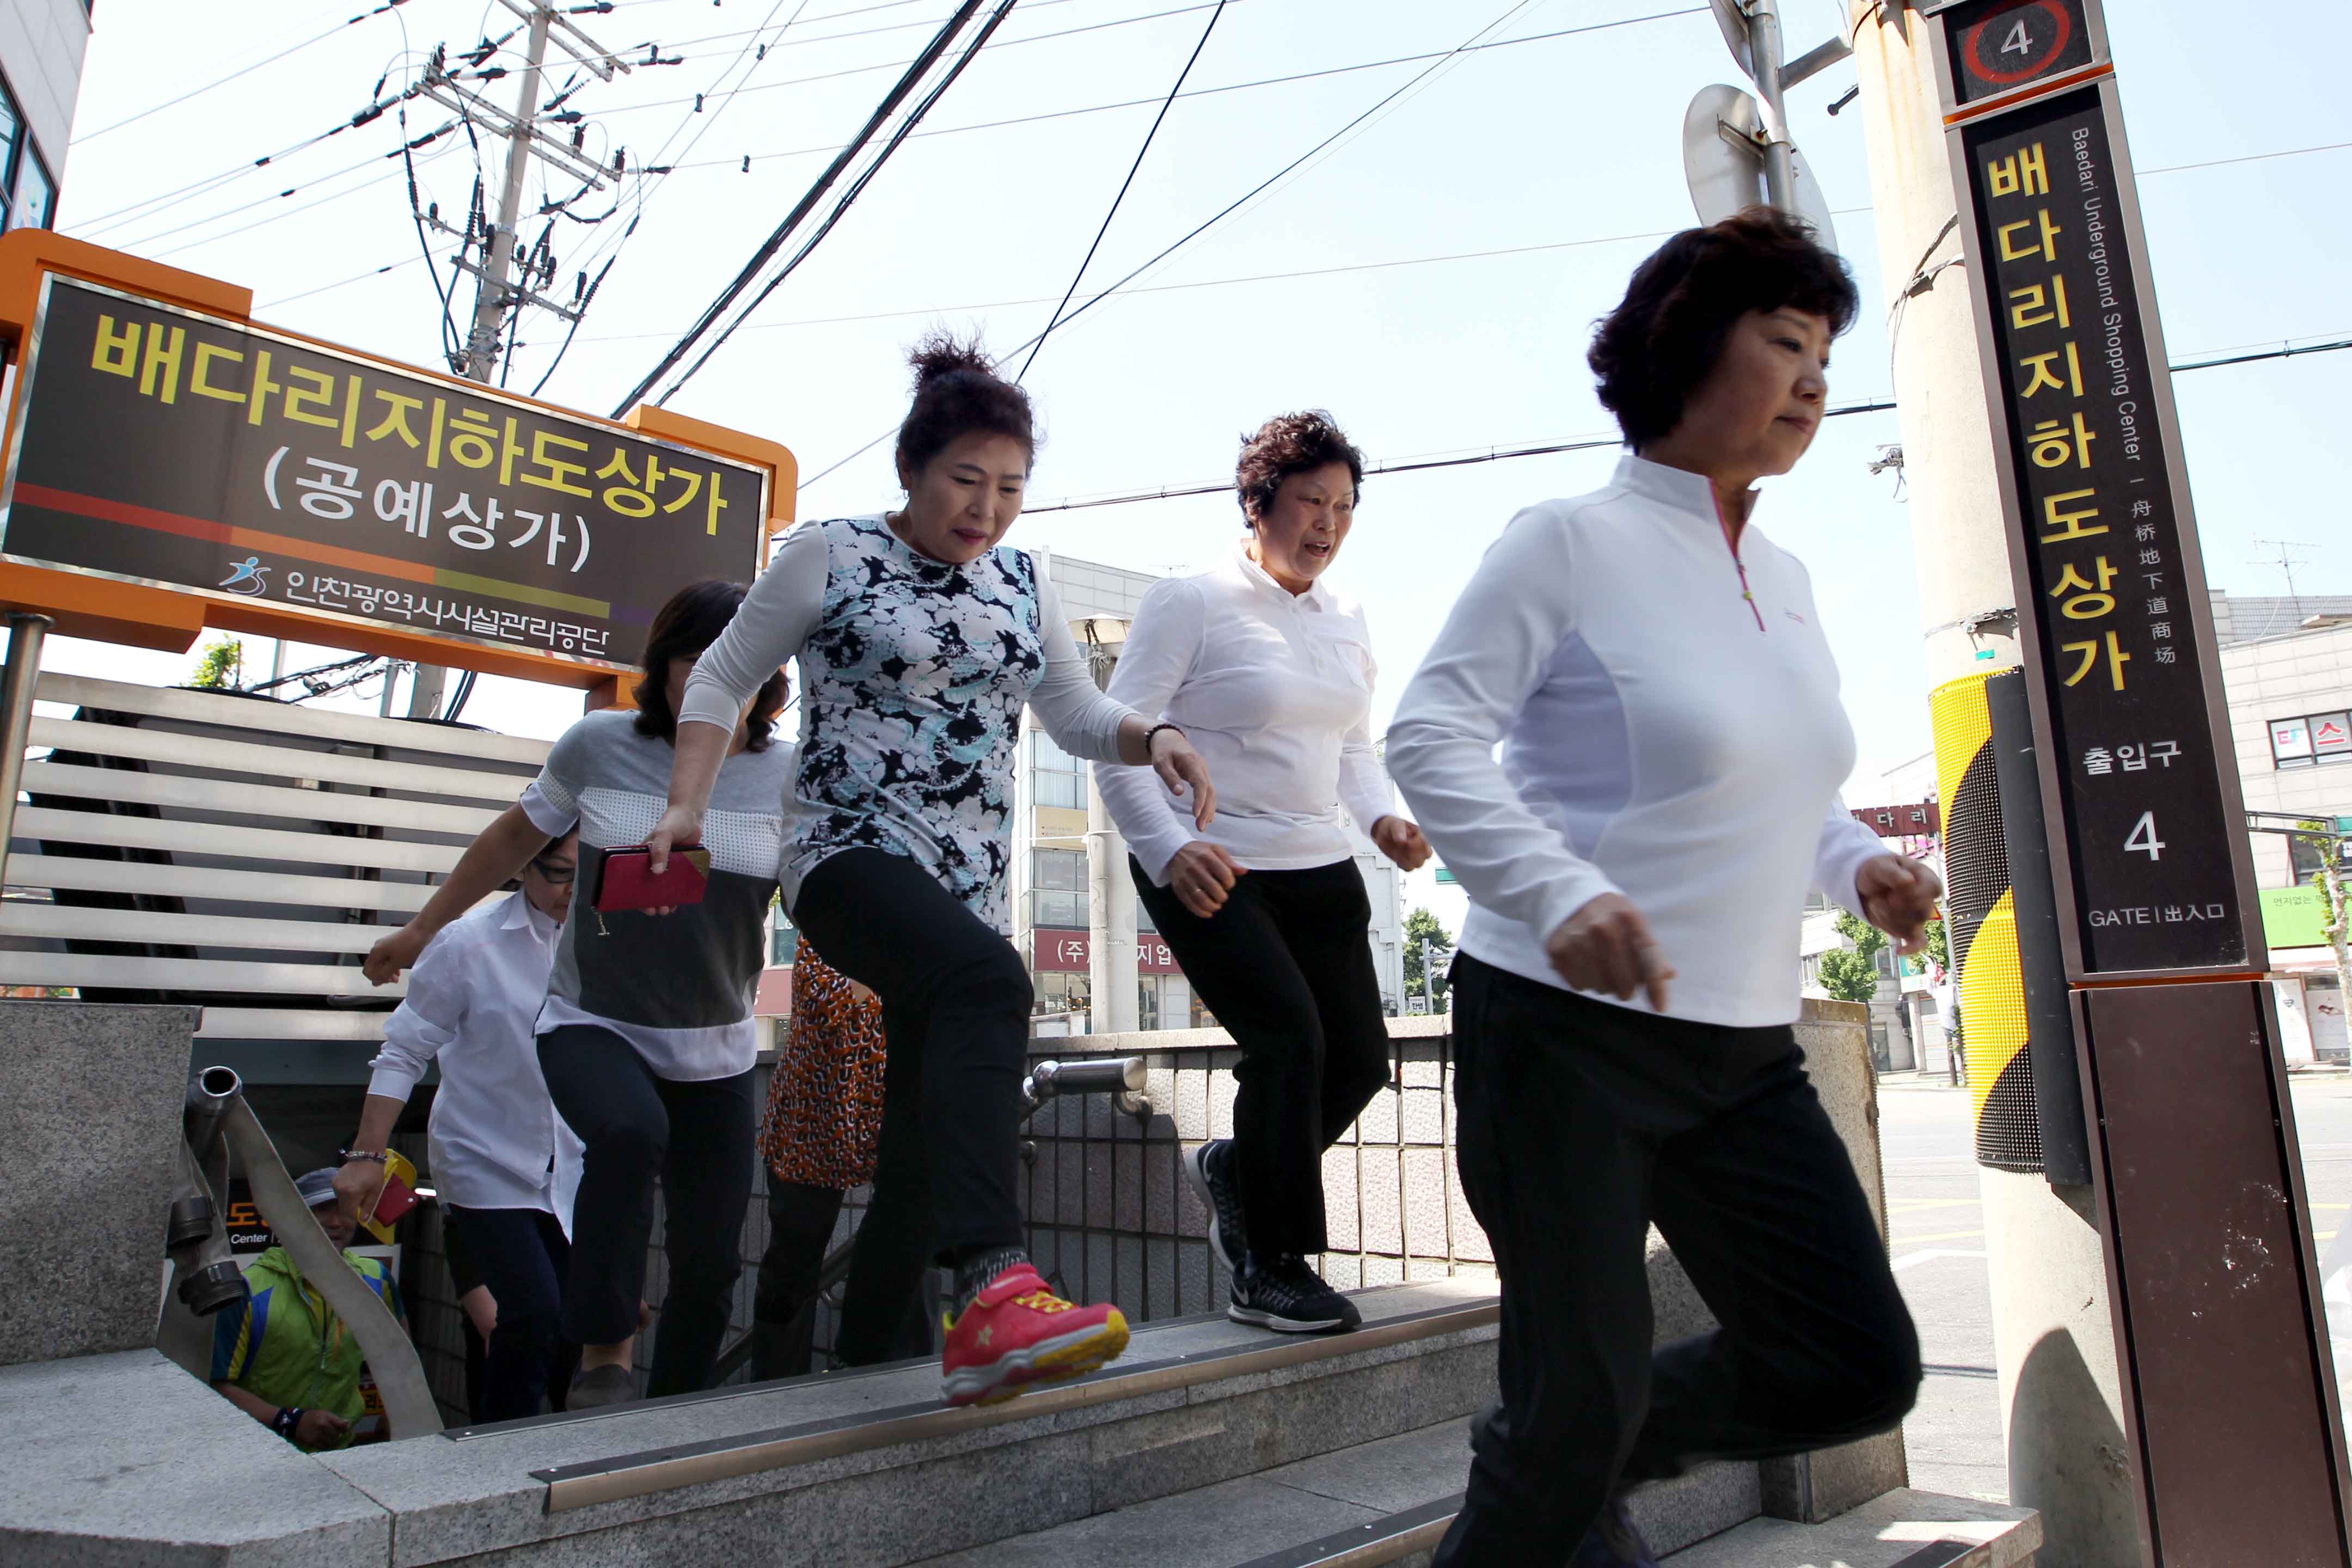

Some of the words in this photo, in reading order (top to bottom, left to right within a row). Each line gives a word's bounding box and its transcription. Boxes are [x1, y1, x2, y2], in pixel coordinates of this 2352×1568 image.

[2000, 19, 2032, 55] 4
[2072, 127, 2099, 192] Baedari
[2084, 197, 2118, 308] Underground
[2104, 313, 2130, 396] Shopping
[92, 315, 728, 536] 배다리지하도상가
[1988, 142, 2130, 691] 배다리지하도상가
[2118, 401, 2141, 461] Center
[264, 445, 591, 573] (공예상가)
[286, 572, 610, 655] 인천광역시시설관리공단
[2131, 499, 2176, 665] 舟桥地下道商场
[2082, 740, 2182, 776] 출입구
[1853, 808, 1927, 828] 다리
[2123, 811, 2166, 861] 4
[2088, 907, 2151, 926] GATE
[2165, 904, 2225, 922] 出入口
[231, 1234, 268, 1244] Center
